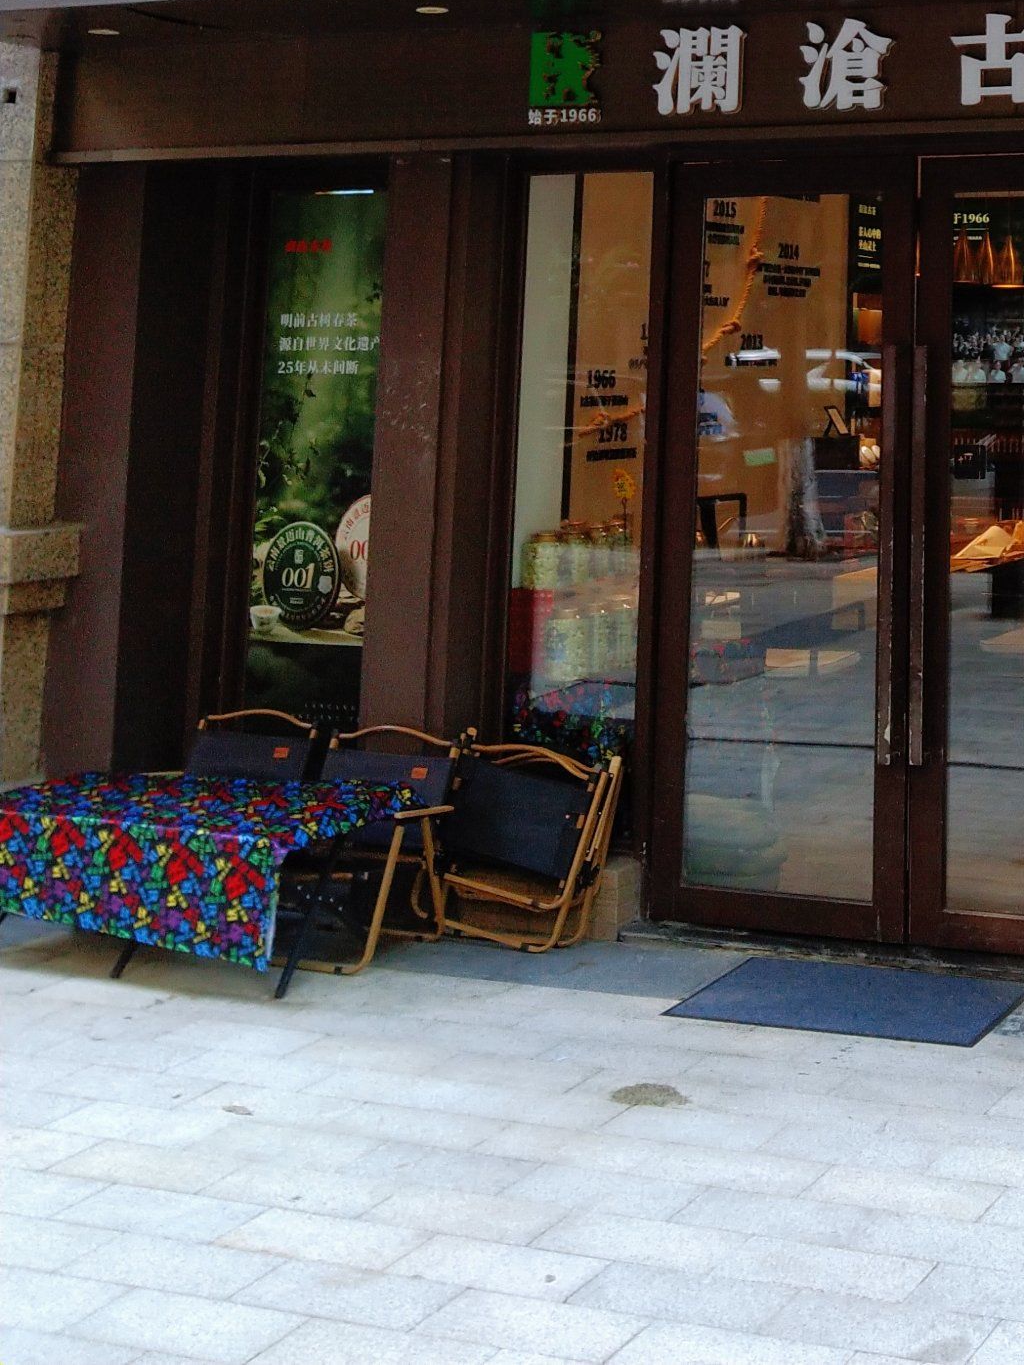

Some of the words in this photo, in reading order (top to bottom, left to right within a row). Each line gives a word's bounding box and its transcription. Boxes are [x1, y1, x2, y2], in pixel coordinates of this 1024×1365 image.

[527, 107, 598, 126] 始于1966
[713, 200, 737, 218] 2015
[778, 242, 800, 261] 2014
[280, 313, 358, 328] 明前古树春茶
[586, 369, 616, 389] 1966
[281, 562, 316, 590] 001
